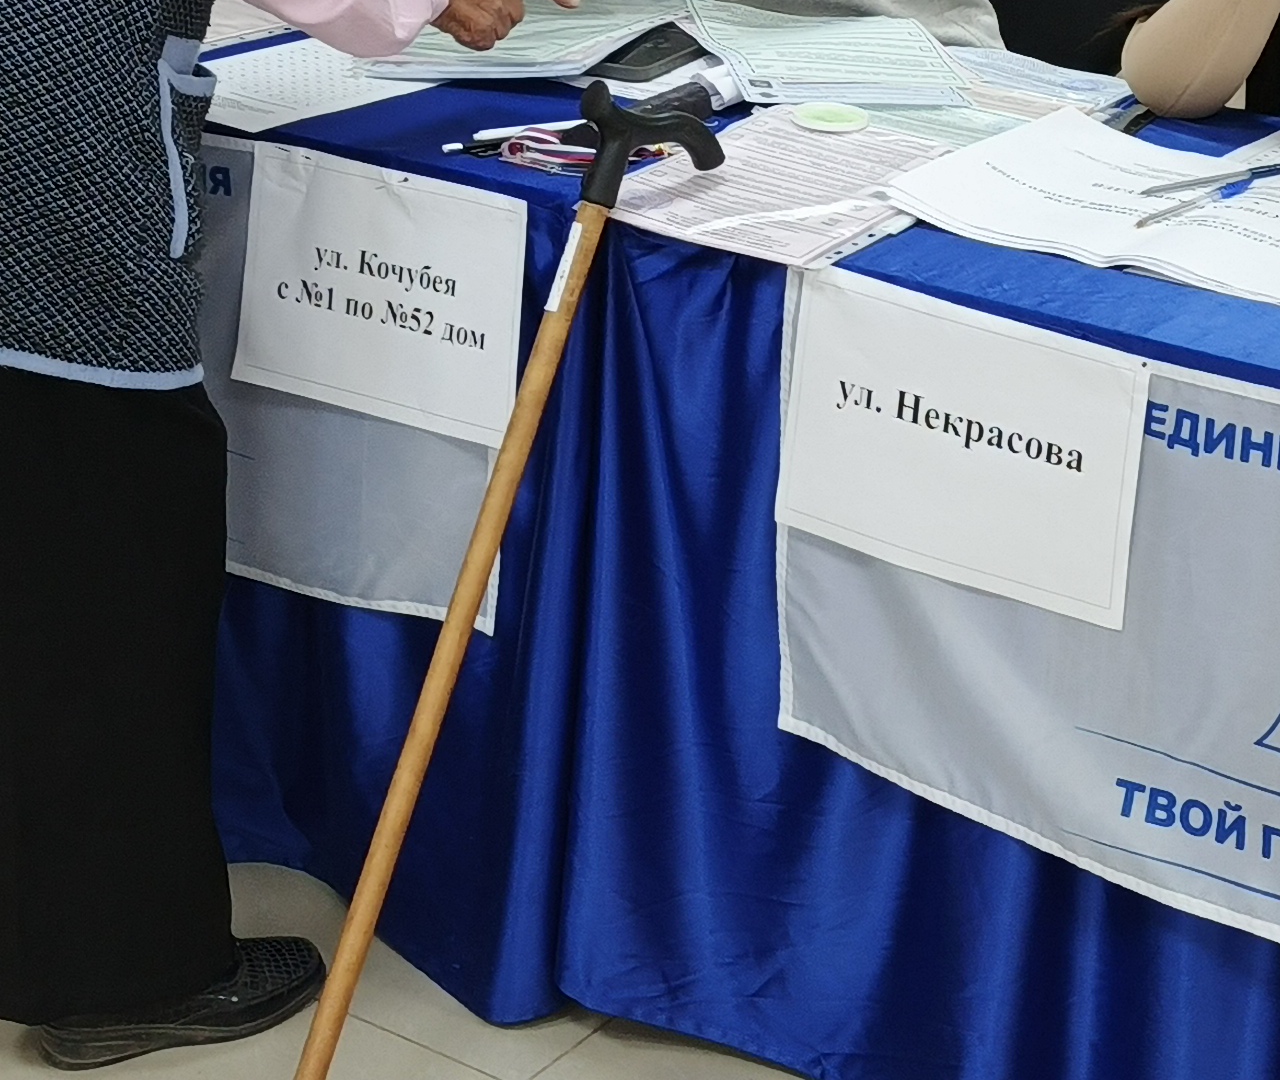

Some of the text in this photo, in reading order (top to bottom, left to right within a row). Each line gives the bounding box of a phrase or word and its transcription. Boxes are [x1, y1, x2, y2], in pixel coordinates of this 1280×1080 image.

[314, 245, 458, 298] ул. Кочубея
[276, 278, 486, 351] с №1 по №52 дом
[835, 379, 1085, 474] ул. Некрасова
[1115, 777, 1249, 853] ТВОЙ
